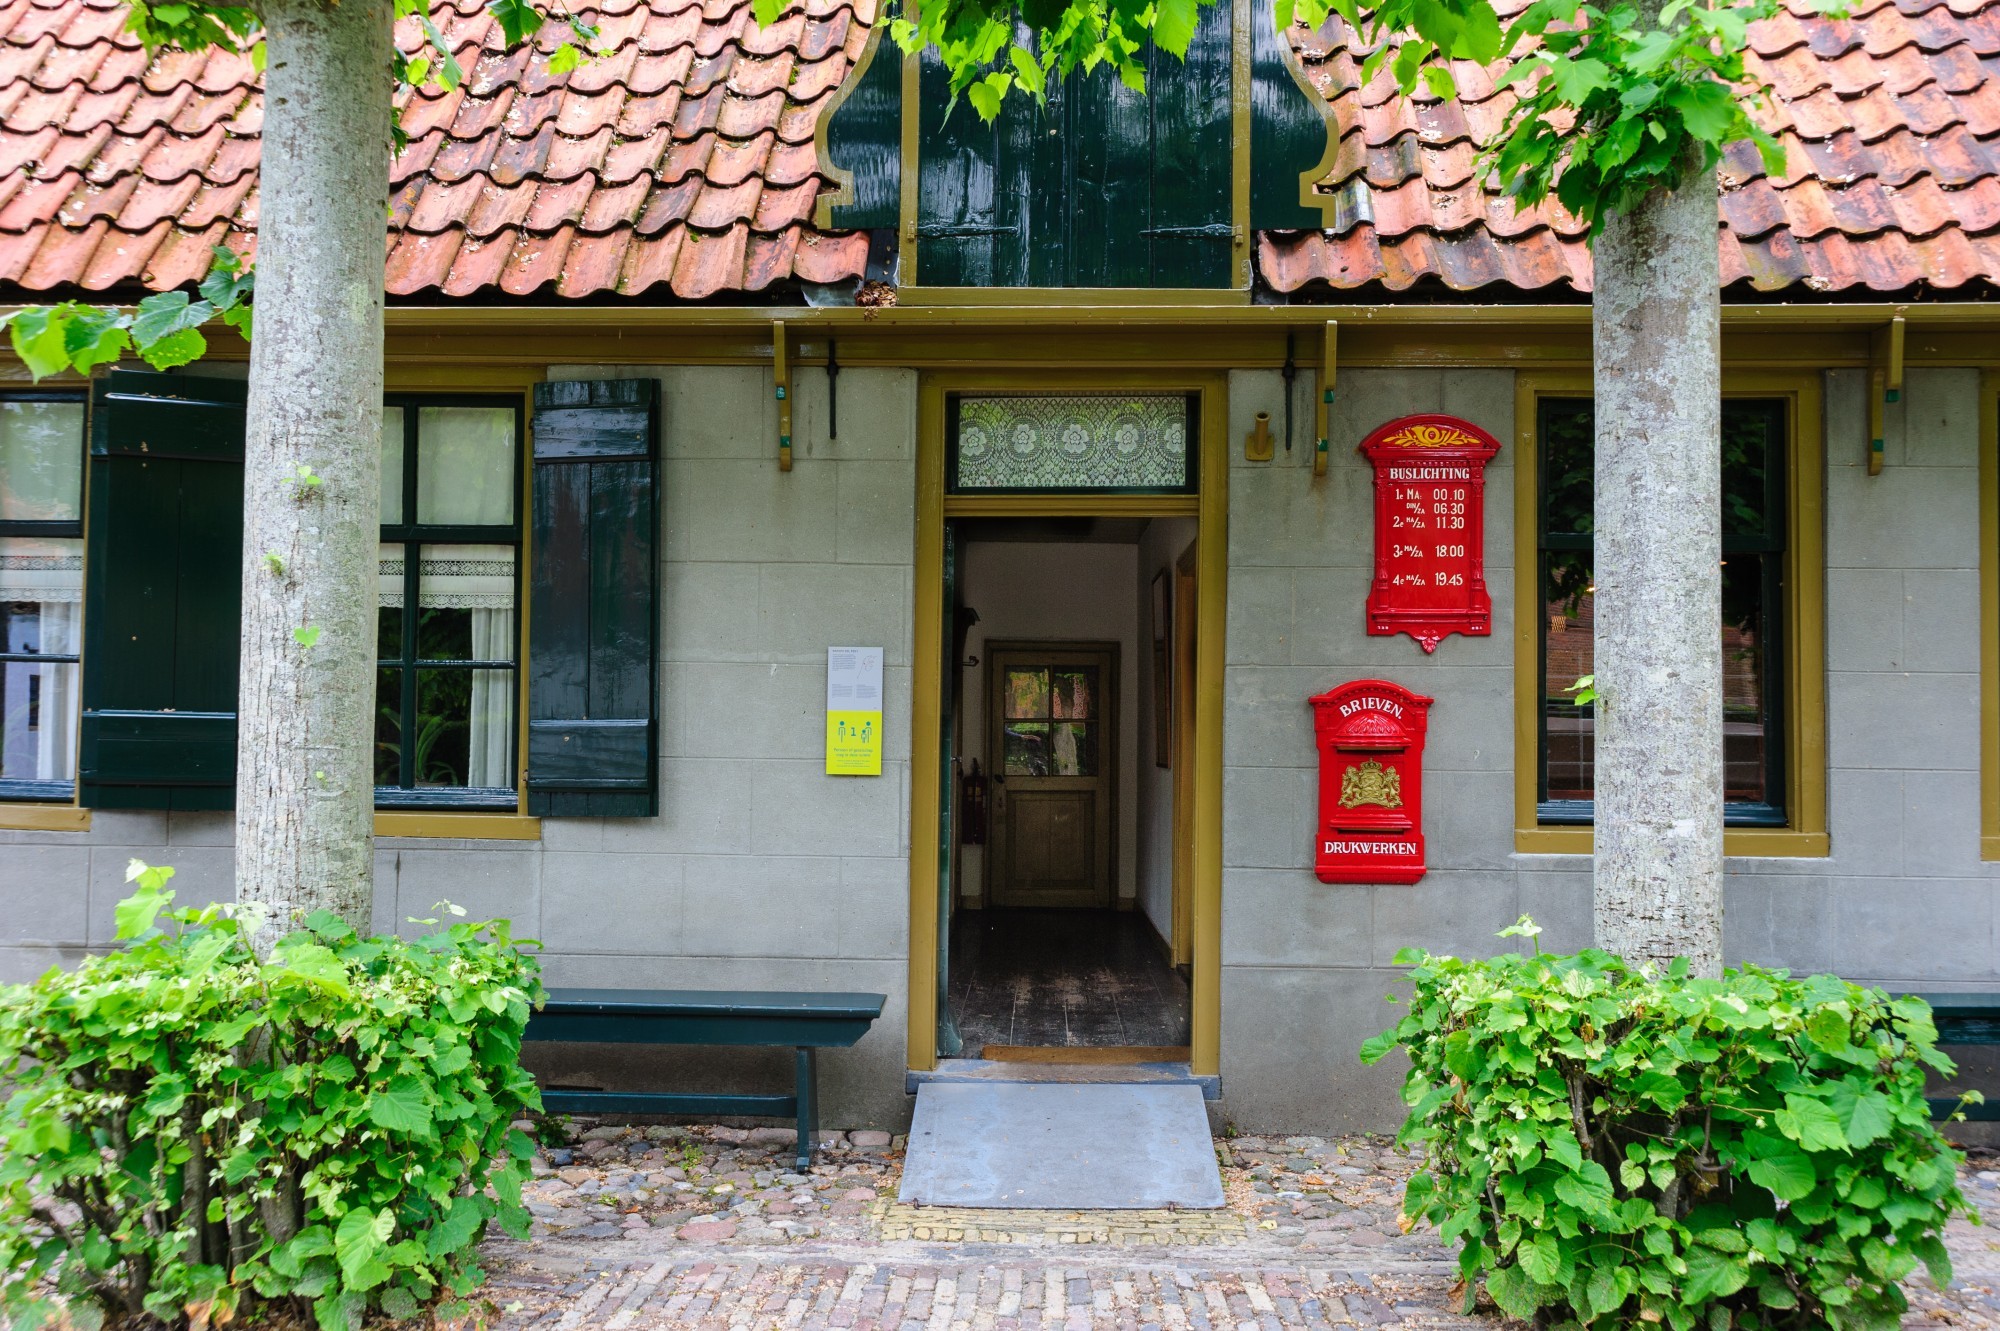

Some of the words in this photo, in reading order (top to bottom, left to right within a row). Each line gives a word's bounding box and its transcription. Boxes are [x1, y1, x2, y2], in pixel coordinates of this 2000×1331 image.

[1390, 468, 1470, 479] BUSLICHTING
[1433, 502, 1465, 514] 06.30
[1436, 516, 1465, 529] 11.30
[1435, 544, 1464, 558] 18.00
[1434, 572, 1463, 586] 19.45
[850, 727, 857, 737] 1
[1324, 841, 1417, 855] DRUKWERKEN
